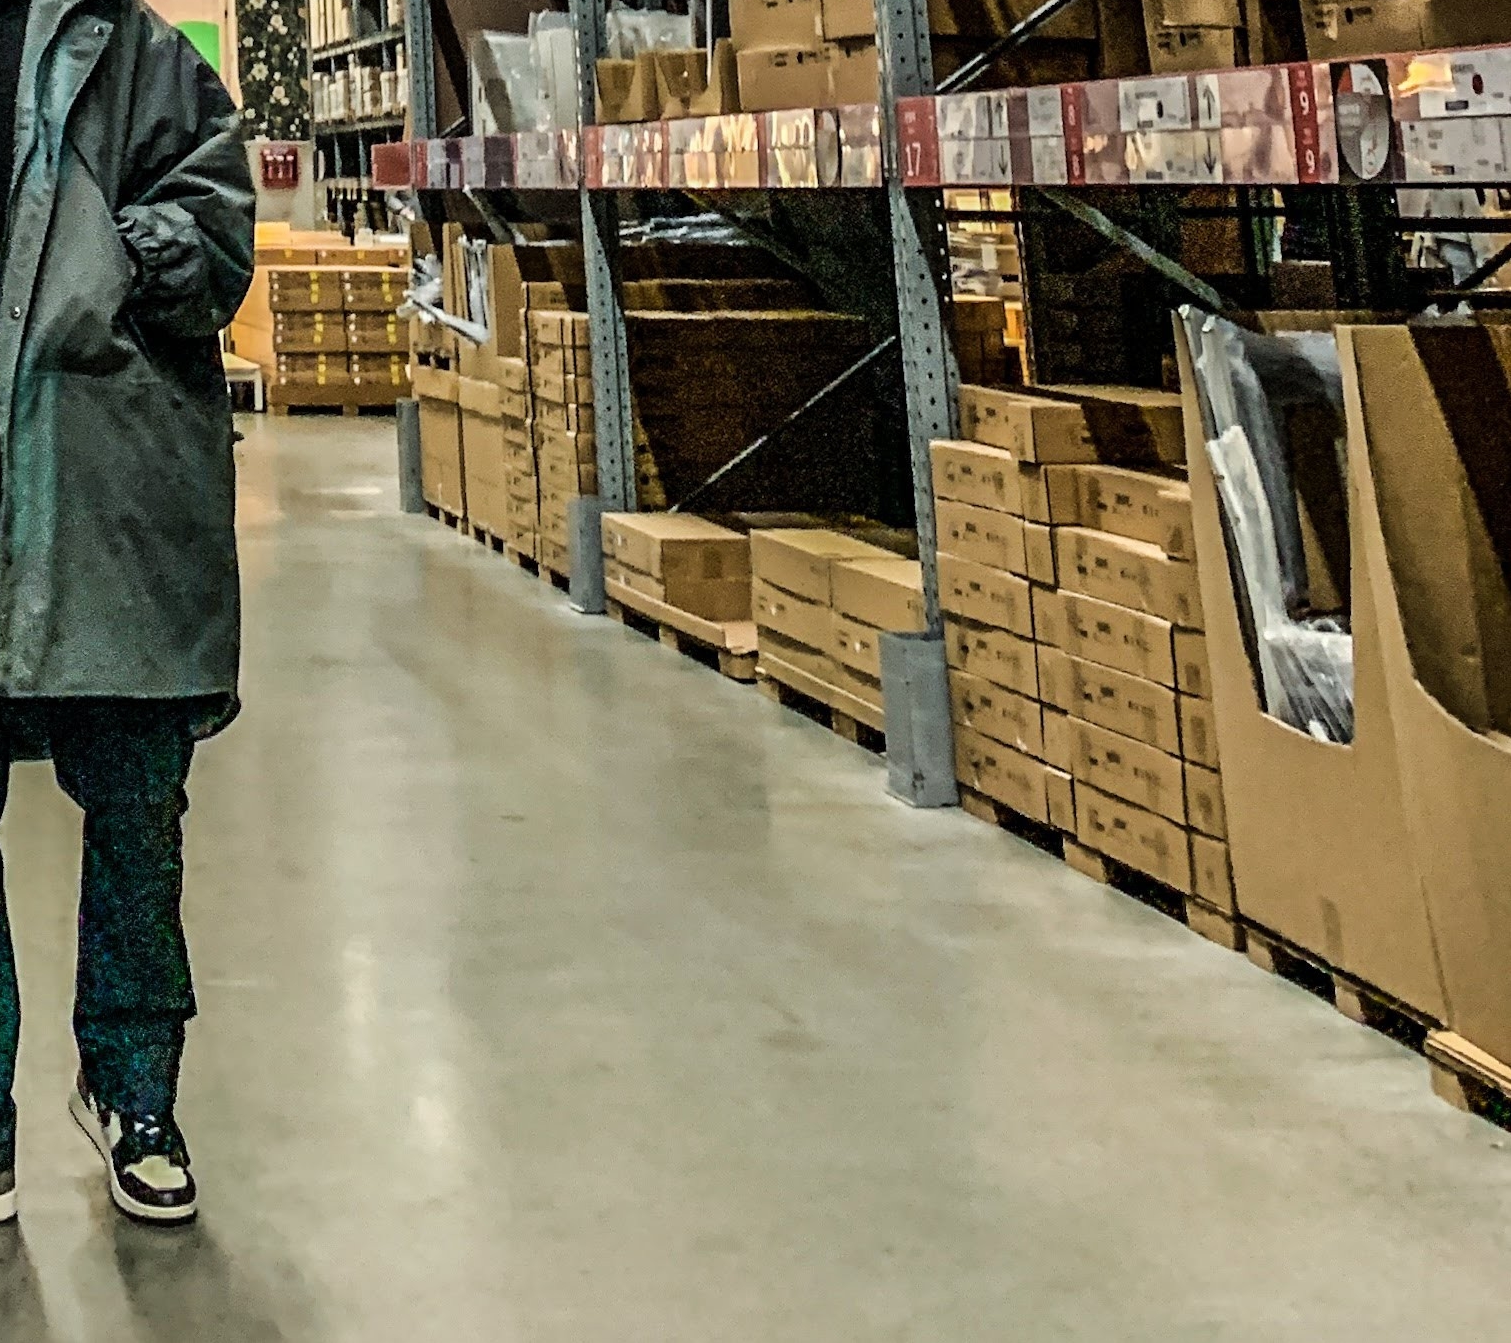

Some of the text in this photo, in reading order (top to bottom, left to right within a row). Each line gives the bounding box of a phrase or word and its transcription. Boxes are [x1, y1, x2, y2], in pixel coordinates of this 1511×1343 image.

[1298, 91, 1310, 116] 9
[904, 141, 922, 178] 17
[1304, 148, 1317, 175] 9
